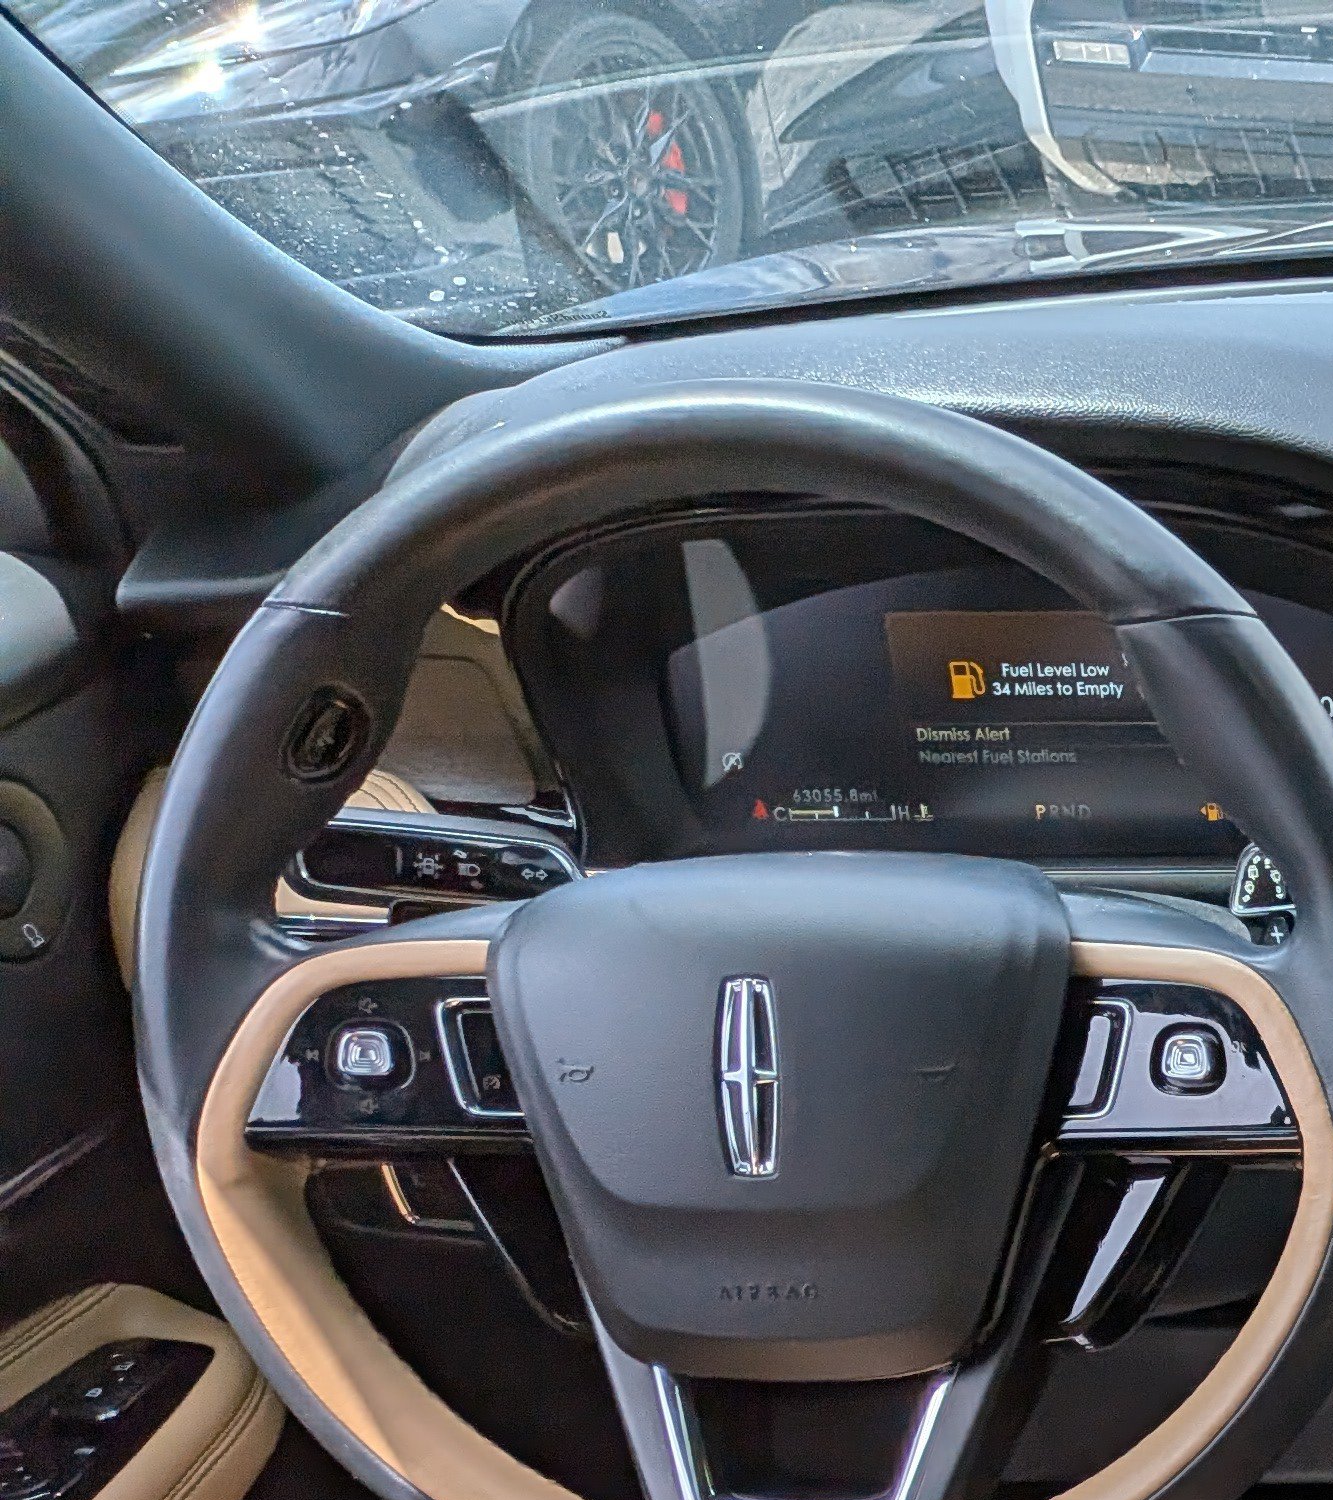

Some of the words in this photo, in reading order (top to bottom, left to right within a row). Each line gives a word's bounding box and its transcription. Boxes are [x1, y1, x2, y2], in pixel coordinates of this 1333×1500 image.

[1001, 663, 1032, 677] Fuel
[1037, 663, 1076, 677] Level
[1080, 664, 1109, 677] Low
[992, 682, 1011, 695] 34
[1014, 682, 1054, 695] Miles
[1057, 683, 1073, 695] to
[1077, 682, 1124, 698] Empty
[916, 727, 970, 742] Dismiss
[975, 727, 1010, 741] Alert
[919, 750, 978, 763] Nearest
[983, 750, 1014, 763] Fuel
[1018, 750, 1076, 763] Stations
